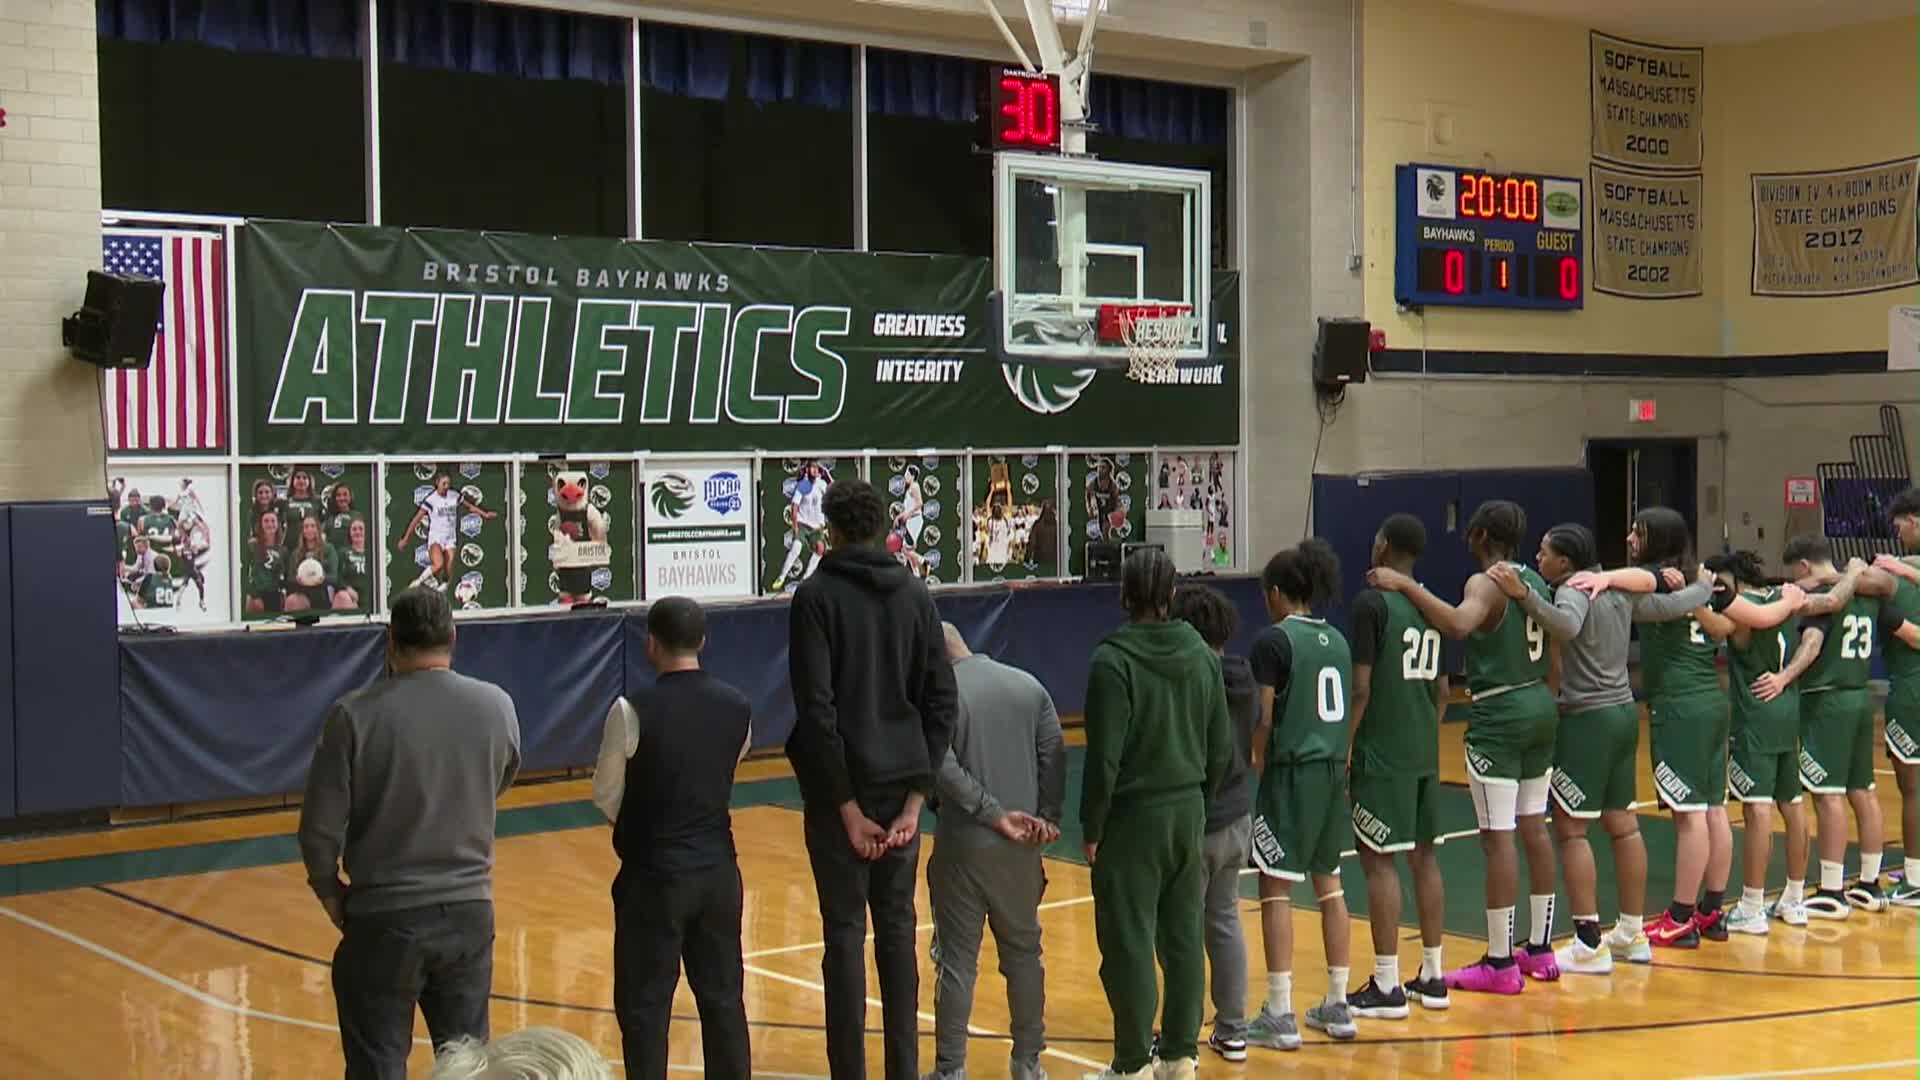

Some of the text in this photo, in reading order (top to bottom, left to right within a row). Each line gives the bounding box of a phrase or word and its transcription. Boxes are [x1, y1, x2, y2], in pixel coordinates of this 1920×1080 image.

[1604, 49, 1690, 78] SOFTBALL
[1600, 74, 1696, 105] MASSACHUSETTS
[1001, 78, 1053, 142] 30
[1607, 103, 1689, 129] STATE CHAMPIONS
[1626, 135, 1669, 154] 2000
[1461, 174, 1538, 221] 20:00
[1604, 182, 1690, 206] SOFTBALL
[1760, 184, 1800, 202] DIVISION
[1879, 170, 1912, 190] RELAY
[1600, 208, 1696, 232] MASSACHUSETTS
[1775, 200, 1897, 225] STATE CHAMPIONS
[1423, 226, 1475, 243] BAYHAWKS
[1484, 239, 1515, 252] PERIOD
[1536, 231, 1575, 250] GUEST
[1607, 235, 1689, 257] STATE CHAMPIONS
[1805, 229, 1863, 248] 2017
[423, 261, 729, 292] BRISTOL BAYHAWKS
[1445, 249, 1464, 295] 0
[1500, 258, 1508, 290] 1
[1559, 256, 1578, 300] 0
[1628, 265, 1670, 282] 2002
[873, 312, 966, 337] GREATNESS
[268, 288, 851, 424] ATHLETICS
[876, 359, 964, 383] INTEGRITY
[673, 549, 720, 560] BRISTOL
[658, 562, 736, 587] BAYHAWKS
[1525, 615, 1544, 662] 9
[1841, 614, 1872, 659] 23
[1403, 627, 1440, 680] 20
[1318, 666, 1344, 722] 0
